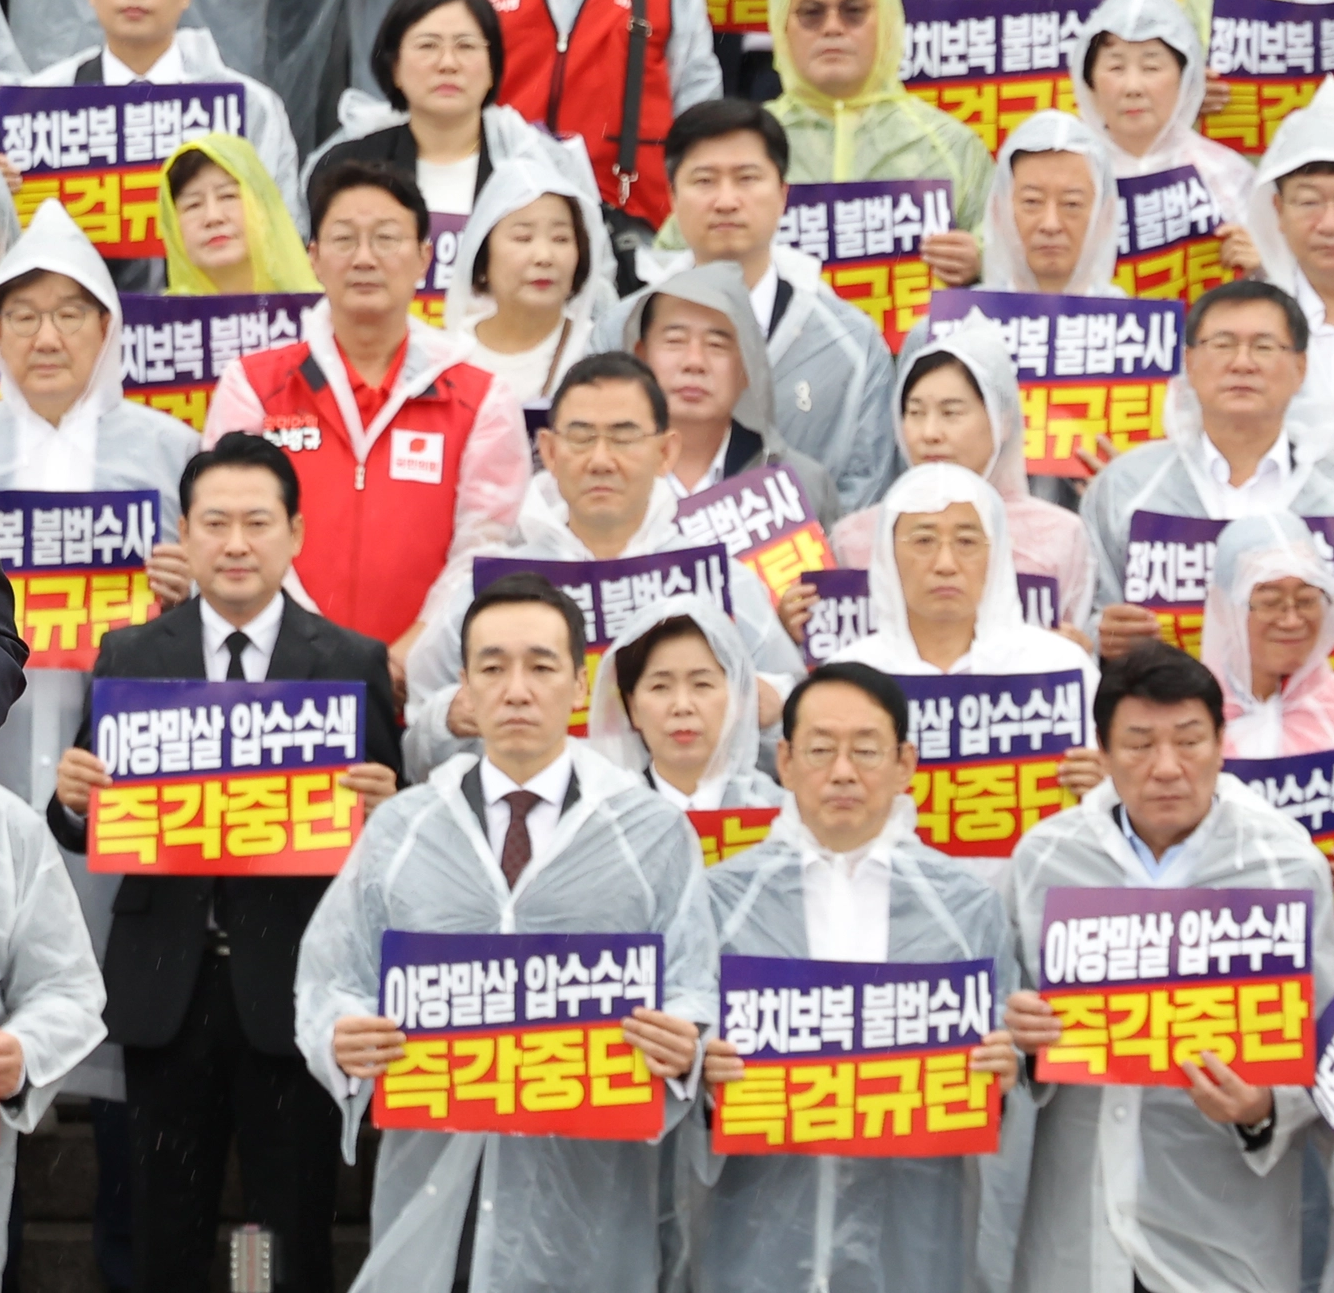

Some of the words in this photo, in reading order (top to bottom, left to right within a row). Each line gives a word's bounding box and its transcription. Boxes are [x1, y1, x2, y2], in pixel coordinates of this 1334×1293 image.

[1212, 16, 1312, 76] 정치보복
[3, 112, 118, 172] 정치보복
[20, 174, 162, 247] 특검규
[833, 190, 951, 254] 불법수사
[120, 322, 205, 385] 치보복
[1056, 314, 1176, 377] 불법수사
[31, 500, 155, 569] 불법수사
[1125, 540, 1217, 602] 정치보
[14, 571, 155, 654] 규탄
[98, 707, 225, 775] 야당말살
[231, 696, 356, 766] 압수수색
[959, 684, 1083, 752] 압수수색
[95, 771, 358, 865] 즉각중단
[912, 765, 1076, 846] 각중단
[1046, 913, 1173, 984] 야당말살
[1178, 902, 1307, 975] 압수수색
[385, 957, 518, 1028] 야당말살
[525, 944, 657, 1019] 압수수색
[725, 984, 855, 1055] 정치보복
[862, 972, 990, 1046] 불법수사
[1047, 982, 1308, 1075] 즉각중단
[385, 1027, 653, 1119] 즉각중단
[722, 1055, 993, 1146] 특검규탄
